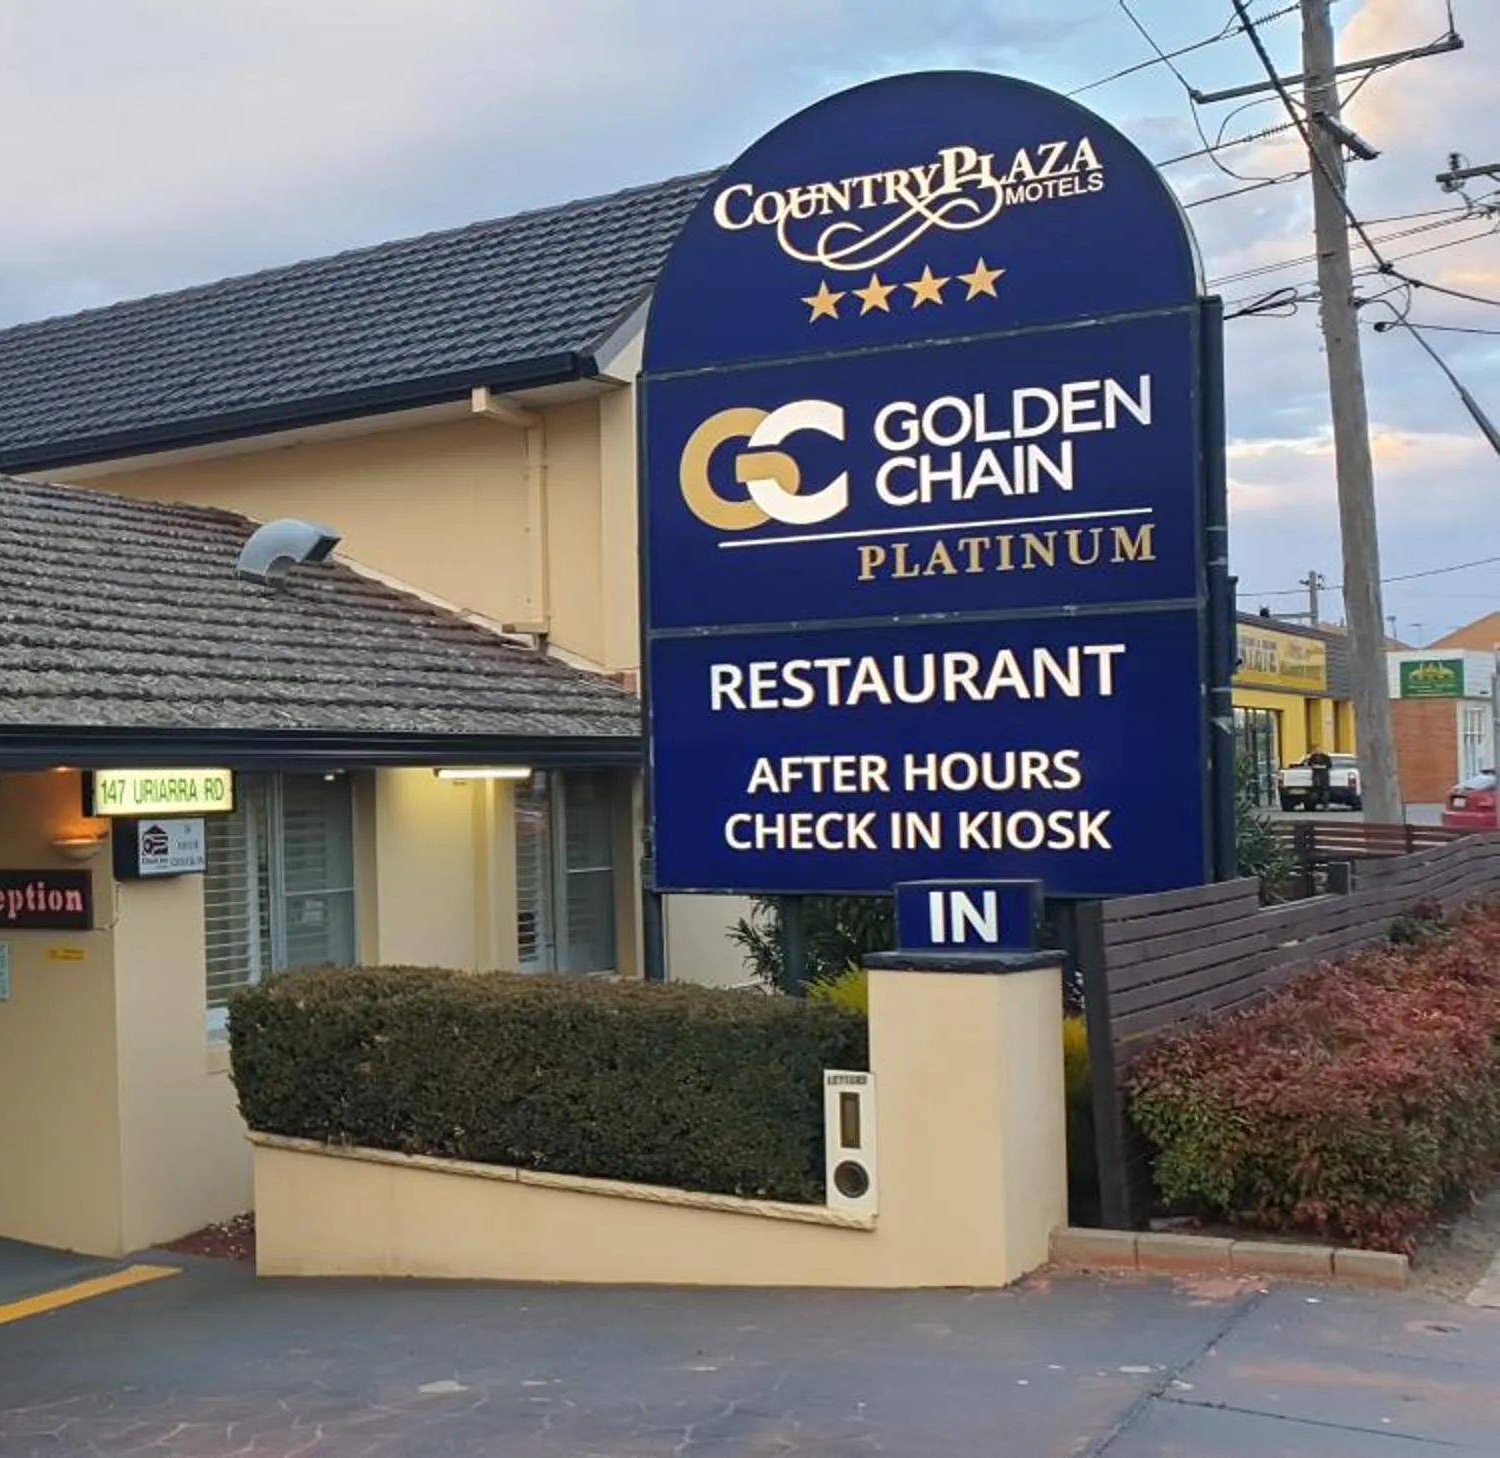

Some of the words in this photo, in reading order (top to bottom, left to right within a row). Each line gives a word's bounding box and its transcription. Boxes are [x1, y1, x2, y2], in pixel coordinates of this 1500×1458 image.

[1005, 172, 1104, 206] MOTELS
[874, 375, 1152, 451] GOLDEN
[875, 441, 1074, 507] CHAIN
[857, 524, 1156, 581] PLATINUM
[710, 643, 1126, 711] RESTAURANT
[100, 779, 125, 804] 147
[133, 778, 198, 804] URIARRA
[203, 777, 225, 801] RD
[747, 754, 890, 794] AFTER
[904, 749, 1081, 791] HOURS
[725, 812, 877, 850] CHECK
[891, 811, 941, 849] IN
[959, 810, 1112, 850] KIOSK
[929, 890, 998, 943] IN
